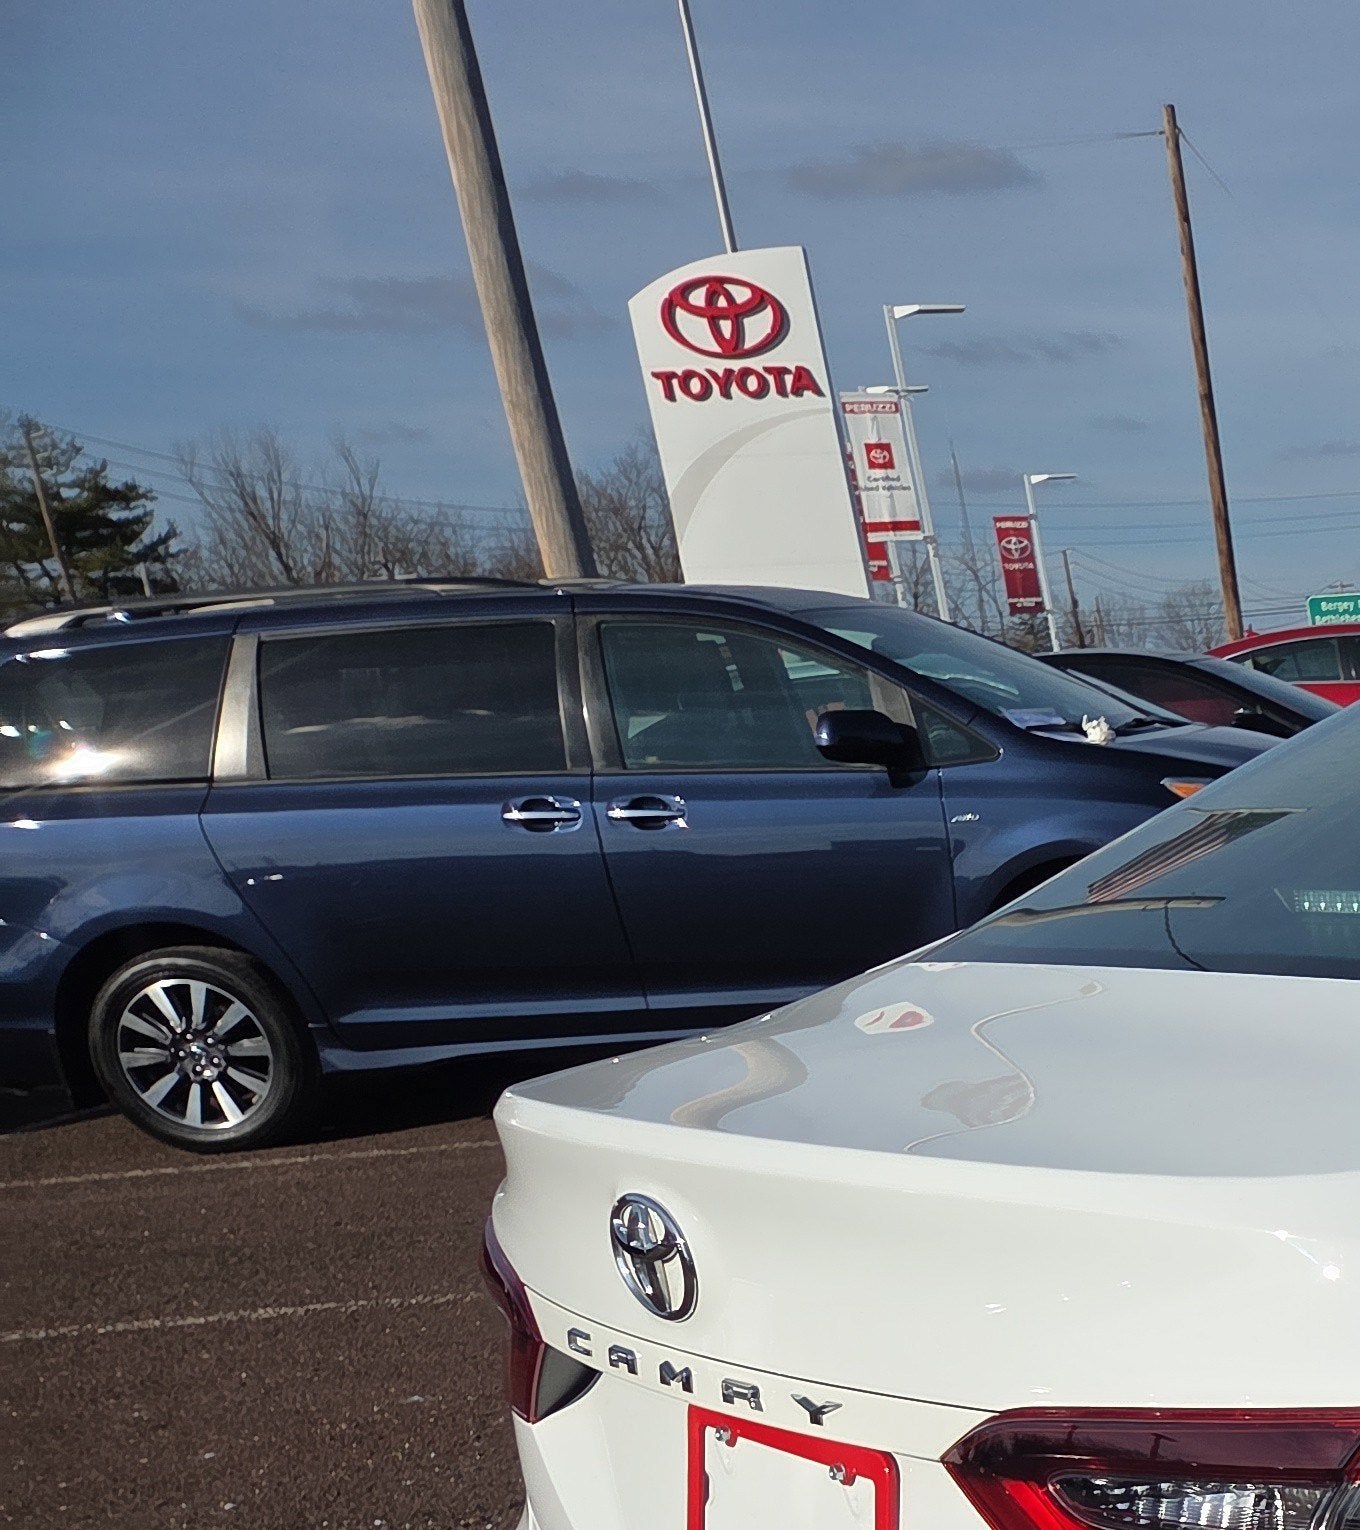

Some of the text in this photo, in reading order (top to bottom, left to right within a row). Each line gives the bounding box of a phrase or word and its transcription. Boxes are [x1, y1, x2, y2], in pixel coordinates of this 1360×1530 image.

[651, 365, 826, 402] TOYOTA
[1321, 601, 1354, 613] Bergey
[567, 1327, 843, 1427] CAMRY
